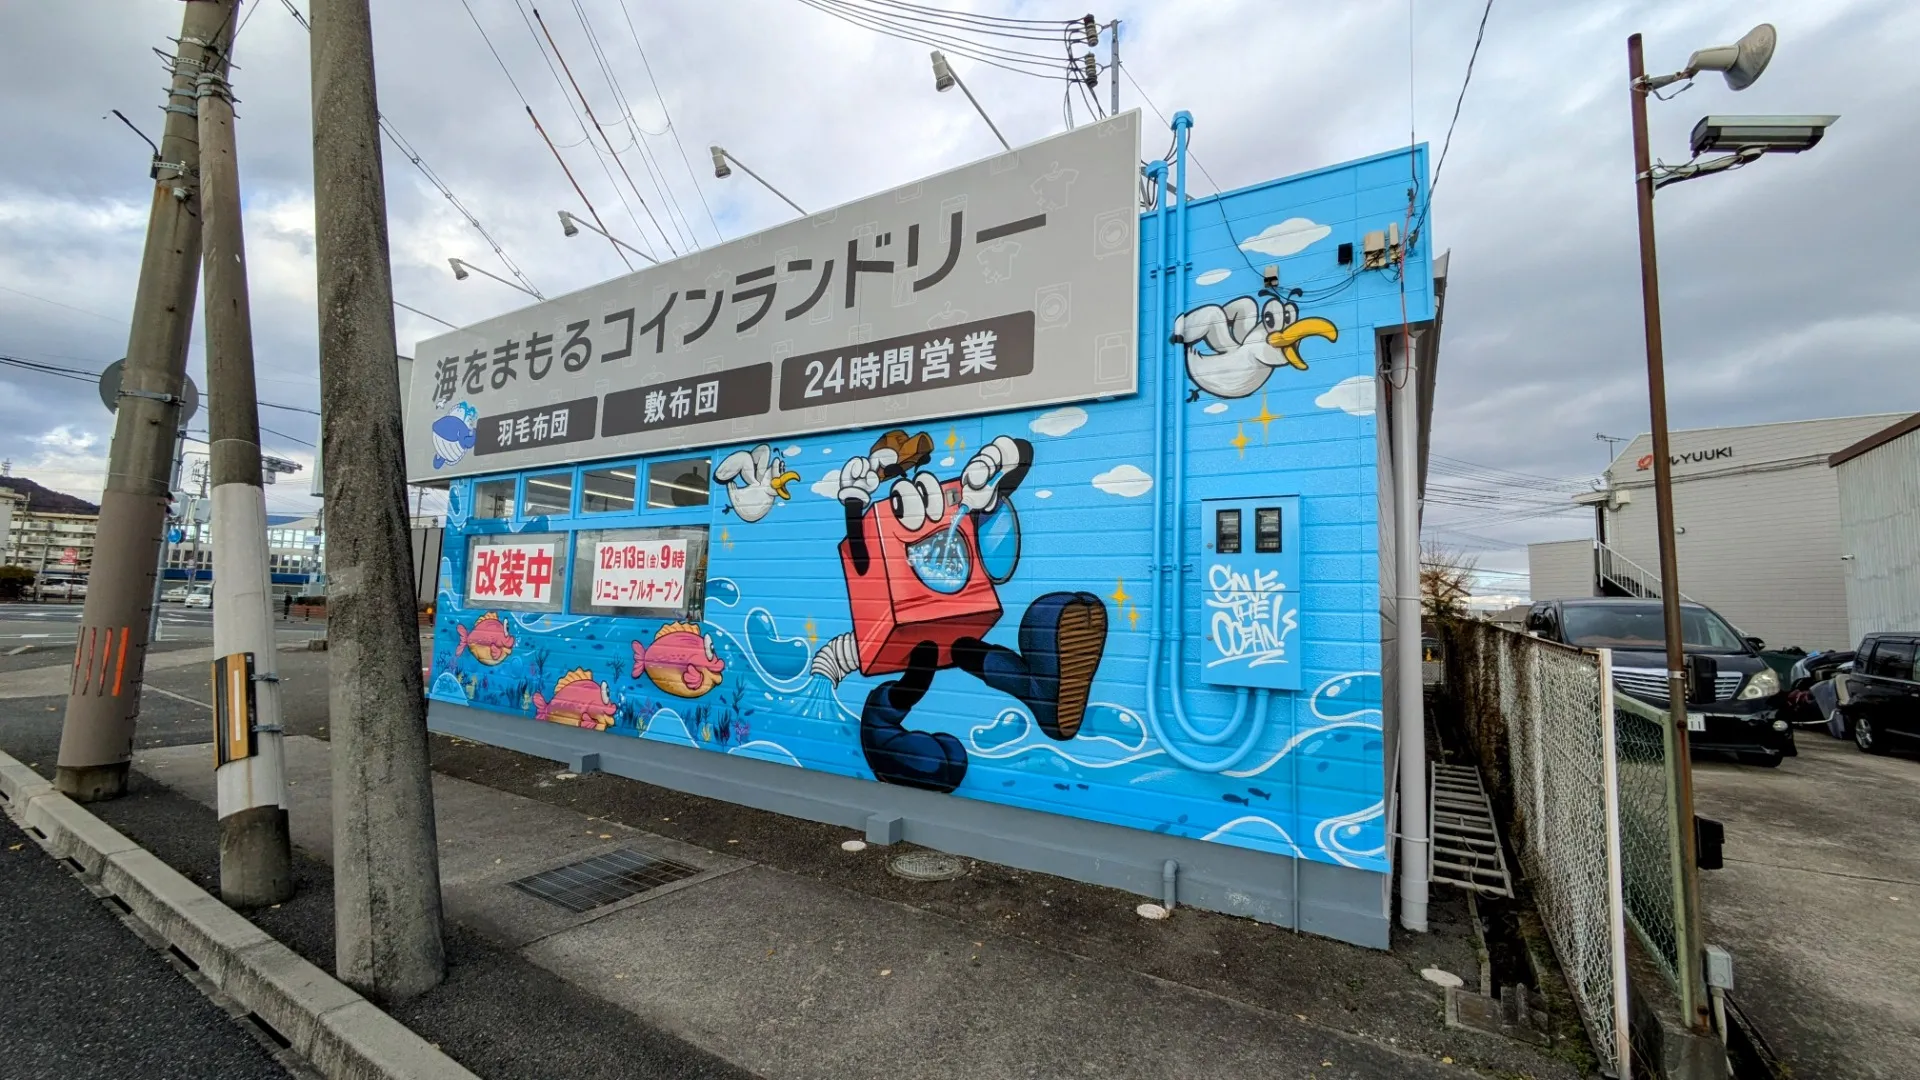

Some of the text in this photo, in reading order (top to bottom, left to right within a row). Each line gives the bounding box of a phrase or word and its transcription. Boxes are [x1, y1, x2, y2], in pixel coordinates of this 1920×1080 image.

[432, 212, 1046, 403] 海をまもるコインランドリー
[804, 330, 998, 397] 24時間営業
[643, 380, 719, 423] 敷布団
[497, 409, 569, 447] 羽毛布団
[475, 548, 552, 599] 改装中
[596, 579, 683, 603] リニューアルオープン
[1209, 564, 1286, 603] SAVE
